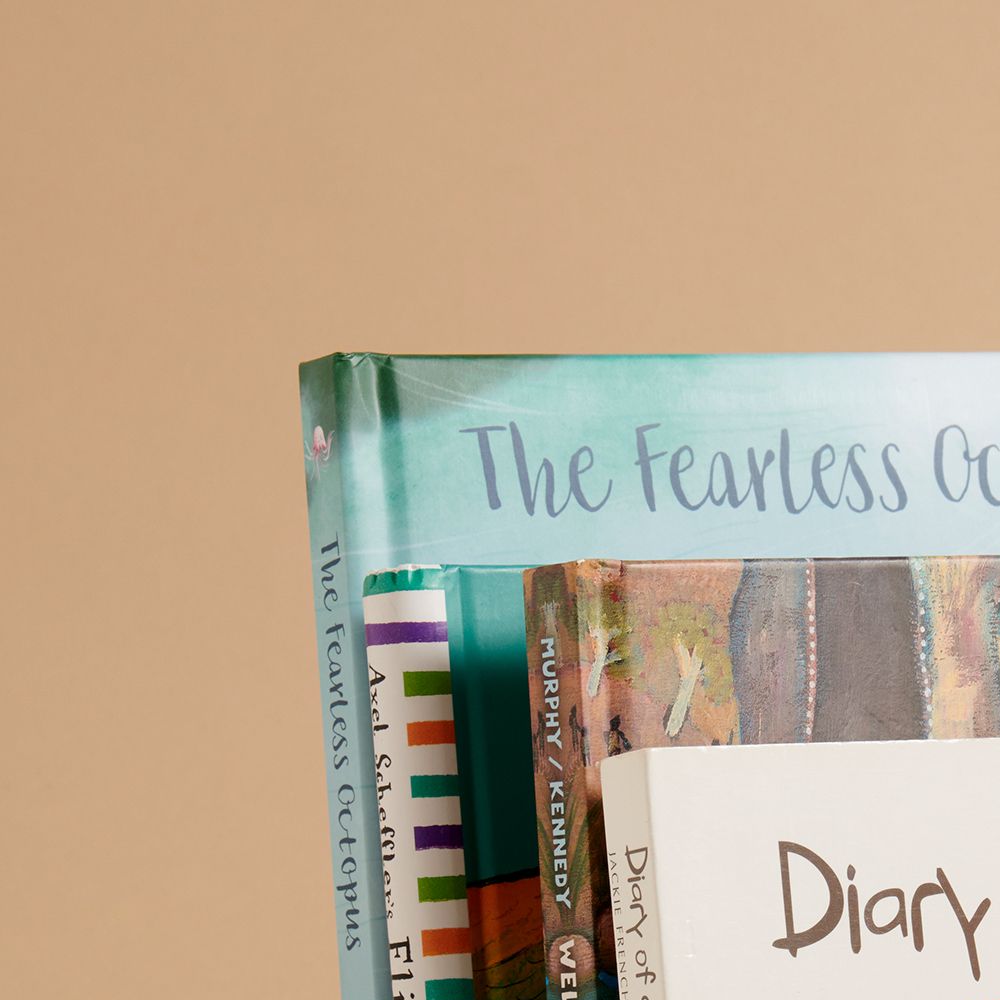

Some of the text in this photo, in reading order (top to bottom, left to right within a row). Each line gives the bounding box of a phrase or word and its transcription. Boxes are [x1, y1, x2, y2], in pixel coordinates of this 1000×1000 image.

[459, 421, 613, 519] The
[634, 422, 908, 516] Fearless
[321, 532, 362, 951] The Fearless Octopus
[540, 637, 563, 750] MURPHY
[549, 781, 571, 909] KENNEDY
[608, 852, 622, 915] JACKIE
[625, 845, 648, 938] Diary
[772, 840, 991, 982] Diary
[635, 950, 656, 985] of
